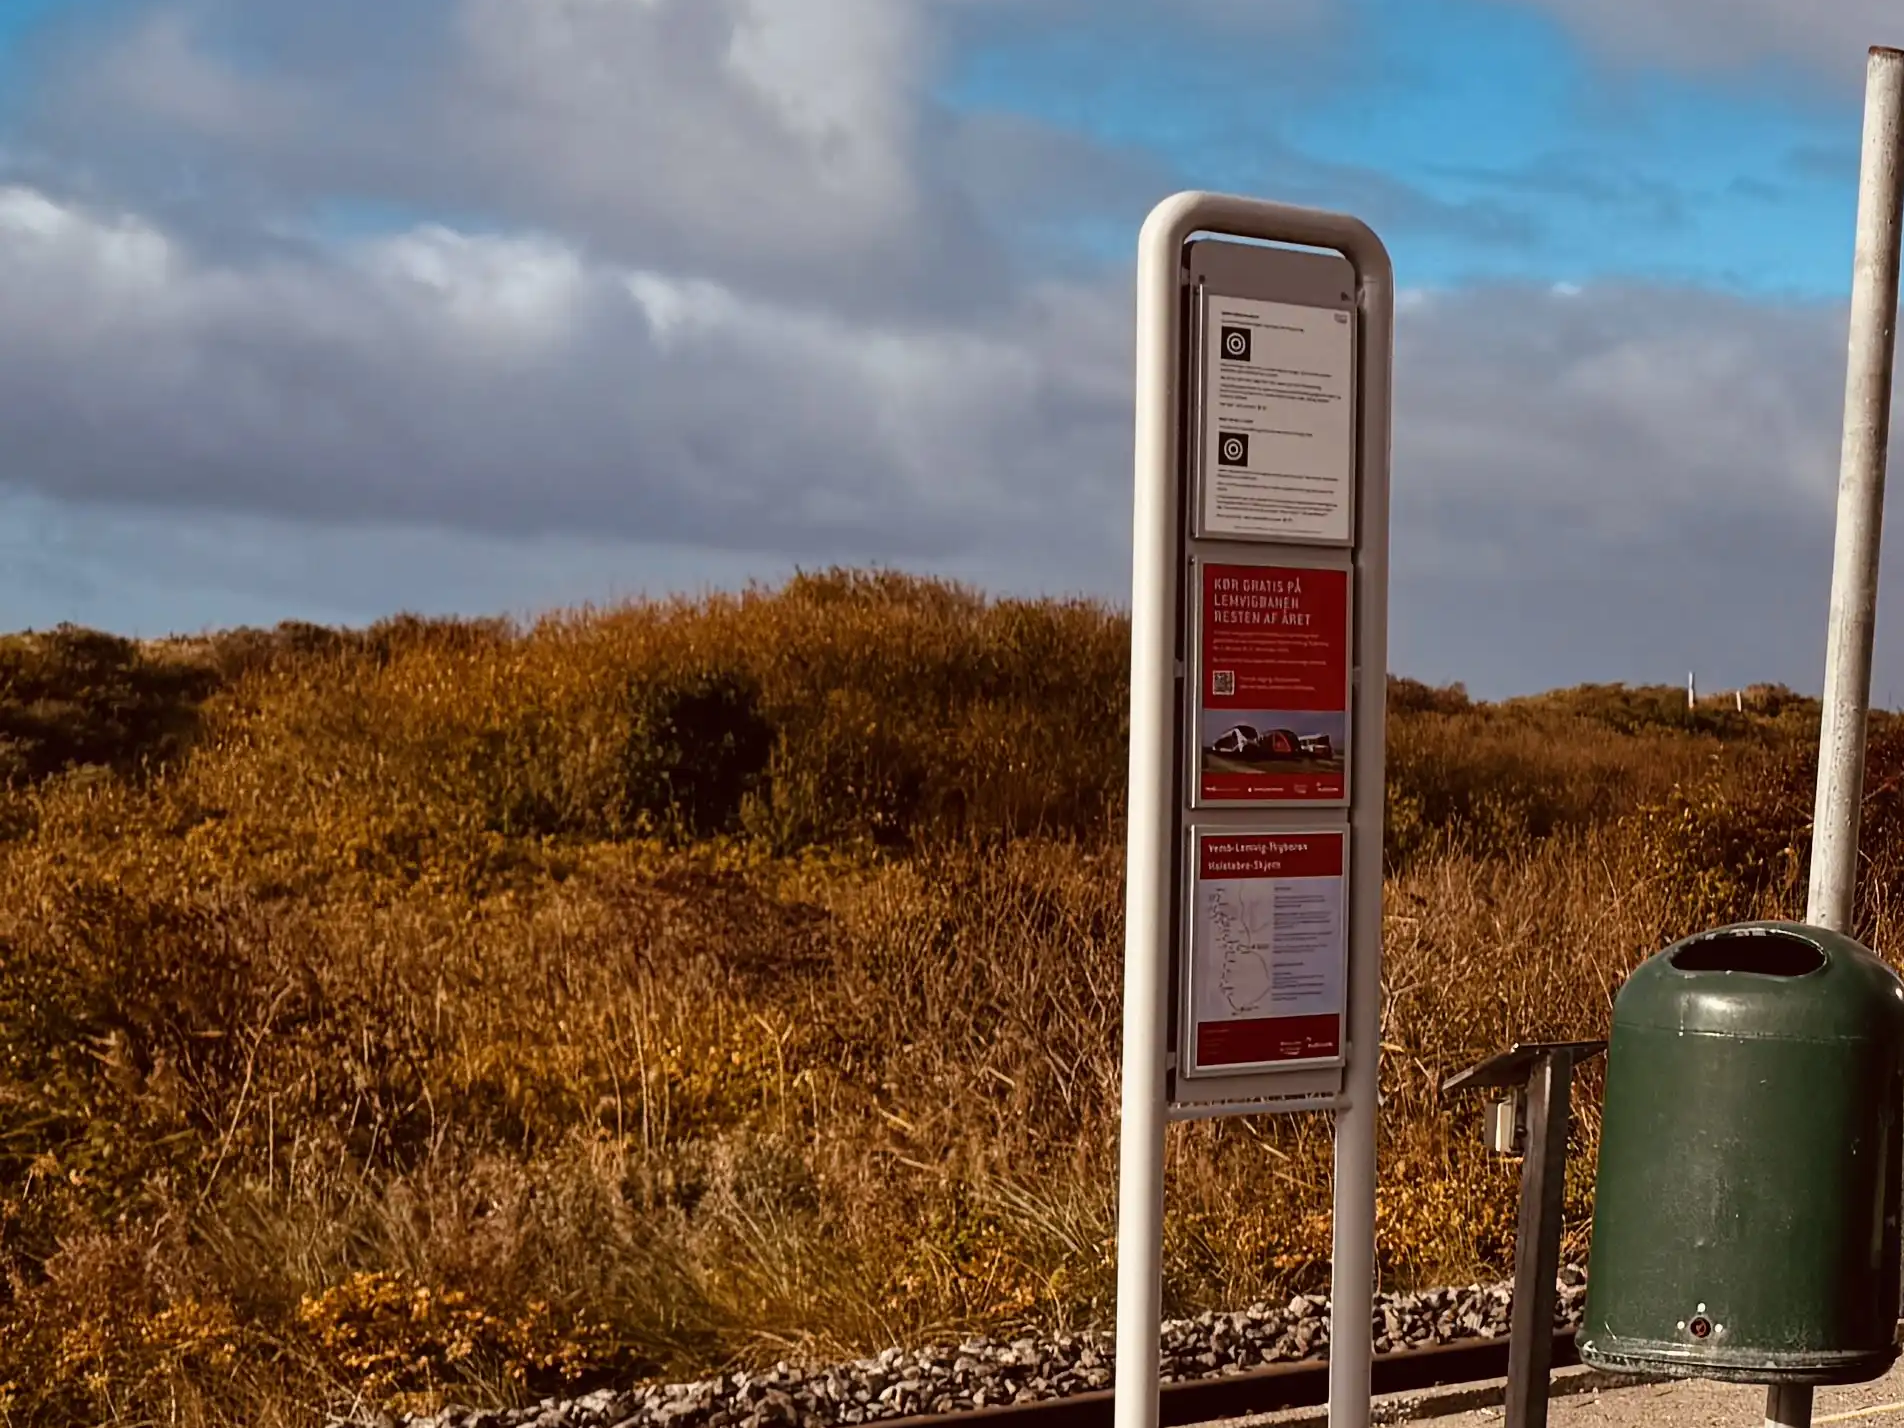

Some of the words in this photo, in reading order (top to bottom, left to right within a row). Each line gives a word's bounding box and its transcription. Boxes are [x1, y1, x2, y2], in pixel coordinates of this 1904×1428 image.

[1214, 577, 1239, 592] KØR
[1243, 579, 1284, 593] GRATIS
[1287, 576, 1302, 594] PÅ
[1214, 609, 1261, 625] RESTEN
